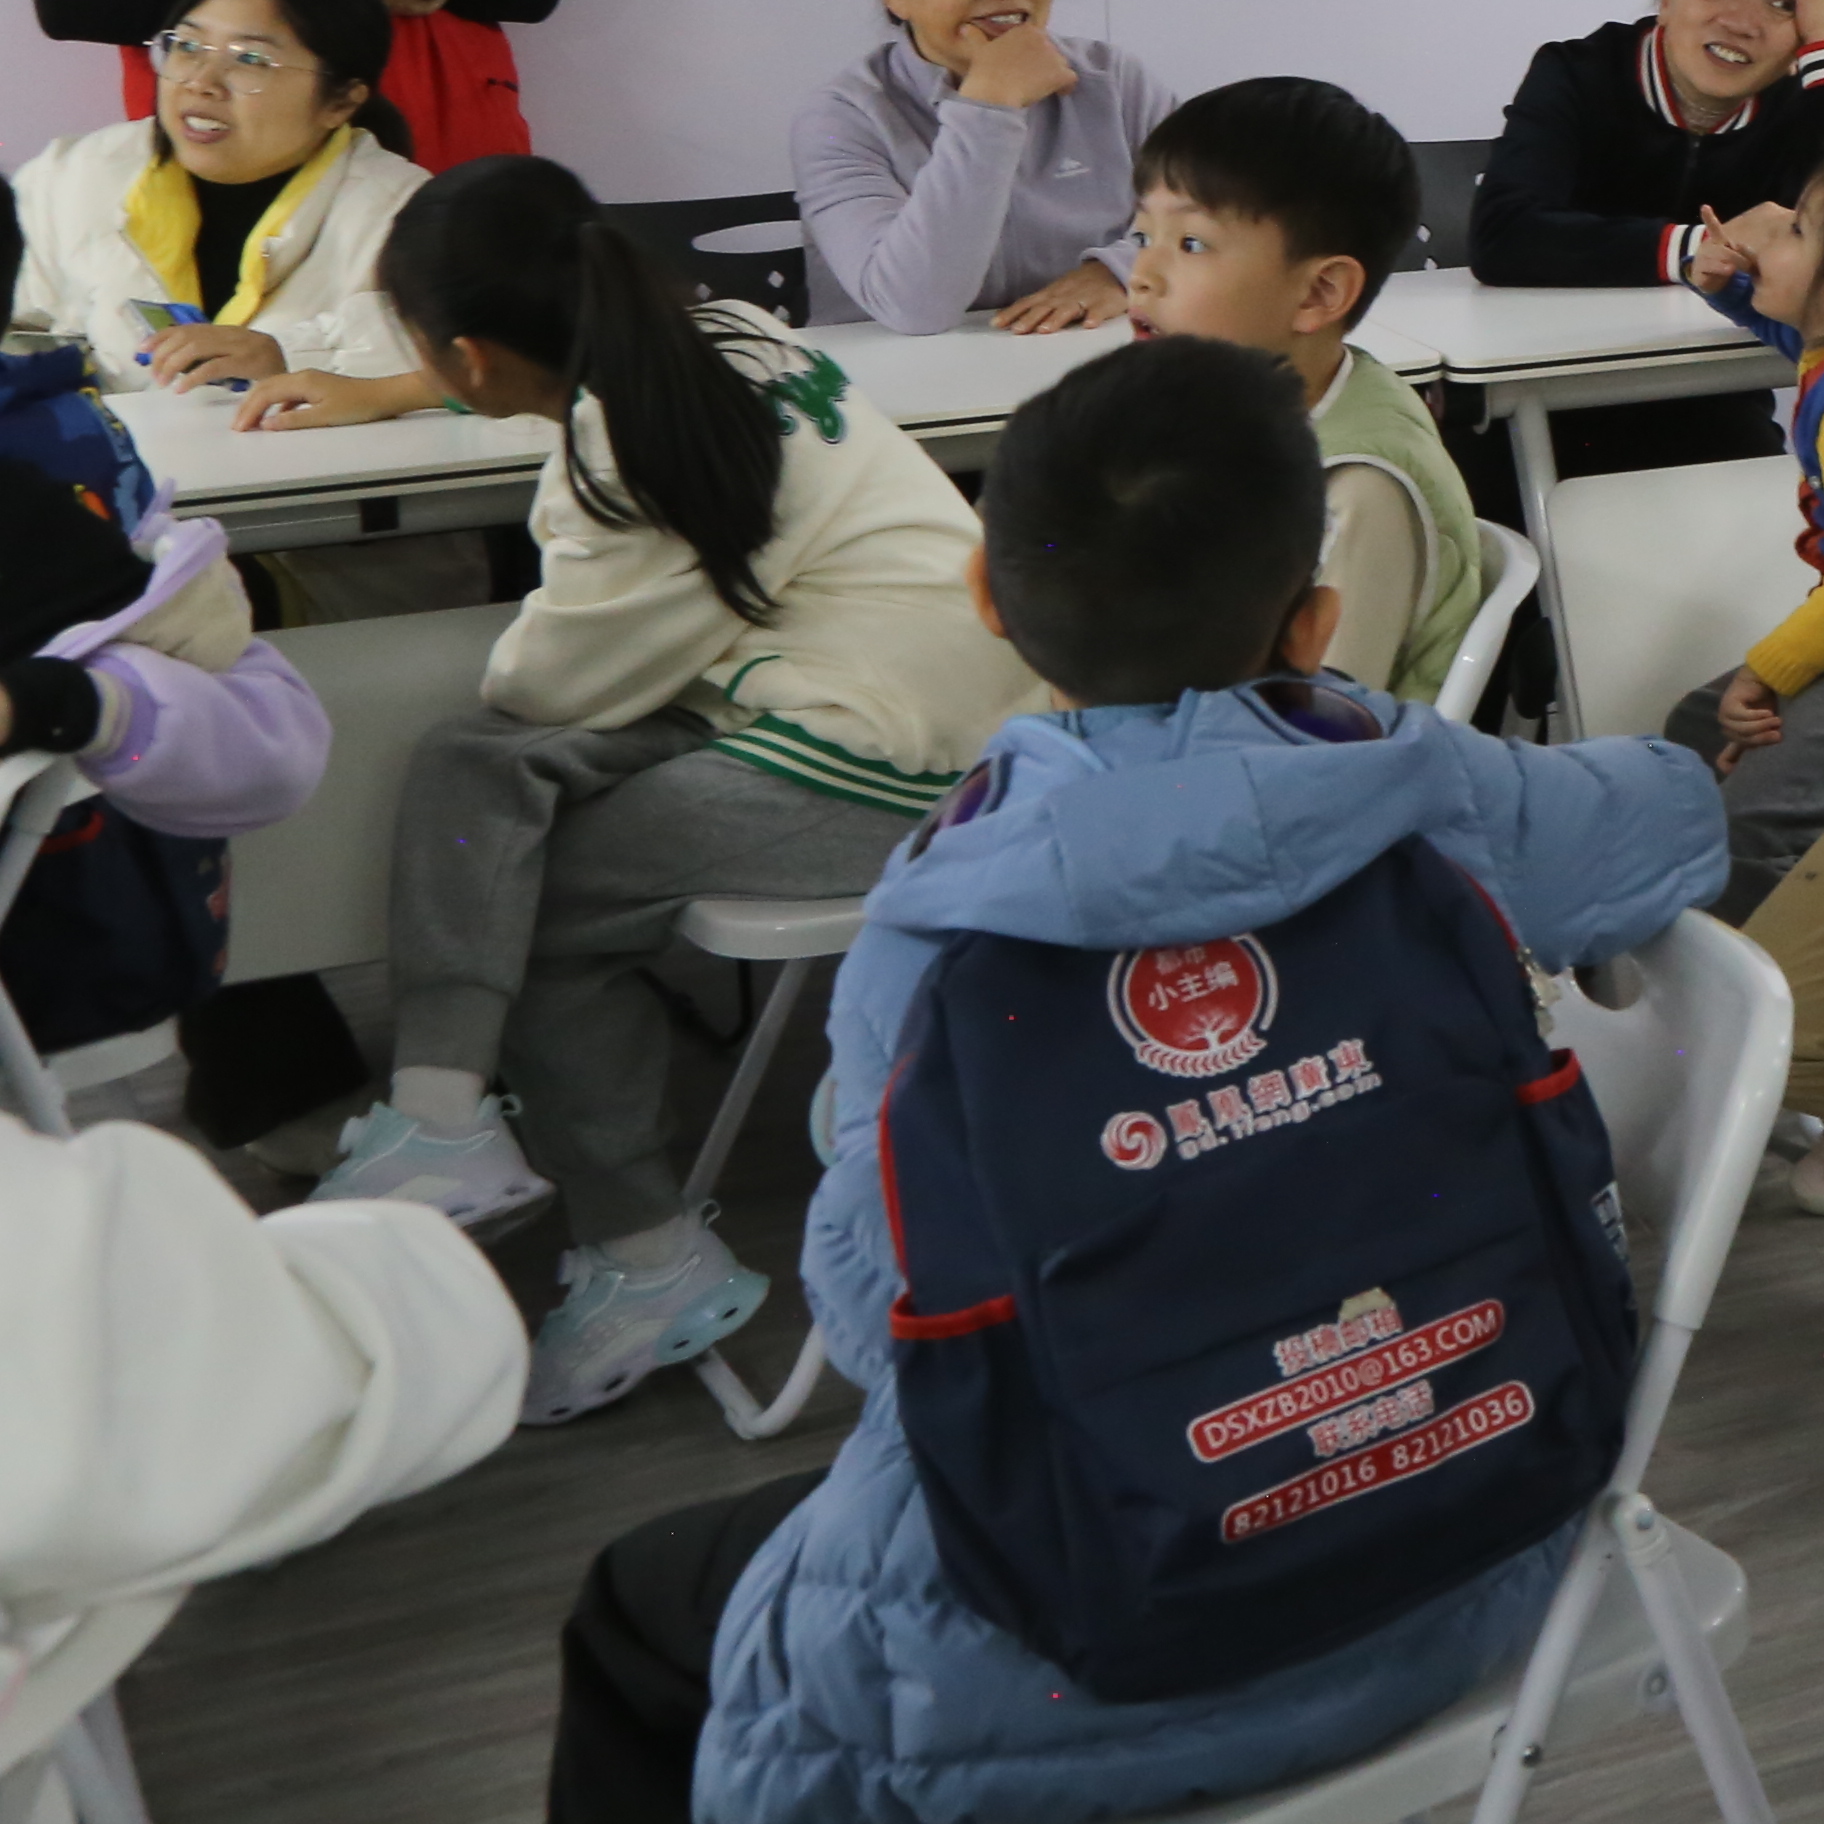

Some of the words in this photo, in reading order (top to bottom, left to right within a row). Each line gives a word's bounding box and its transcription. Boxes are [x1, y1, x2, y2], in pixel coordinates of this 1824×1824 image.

[1148, 960, 1239, 1011] 小主编
[1203, 1307, 1497, 1450] DSXZB2010@163.COM
[1232, 1456, 1377, 1535] 82121016
[1391, 1391, 1524, 1470] 82121036
